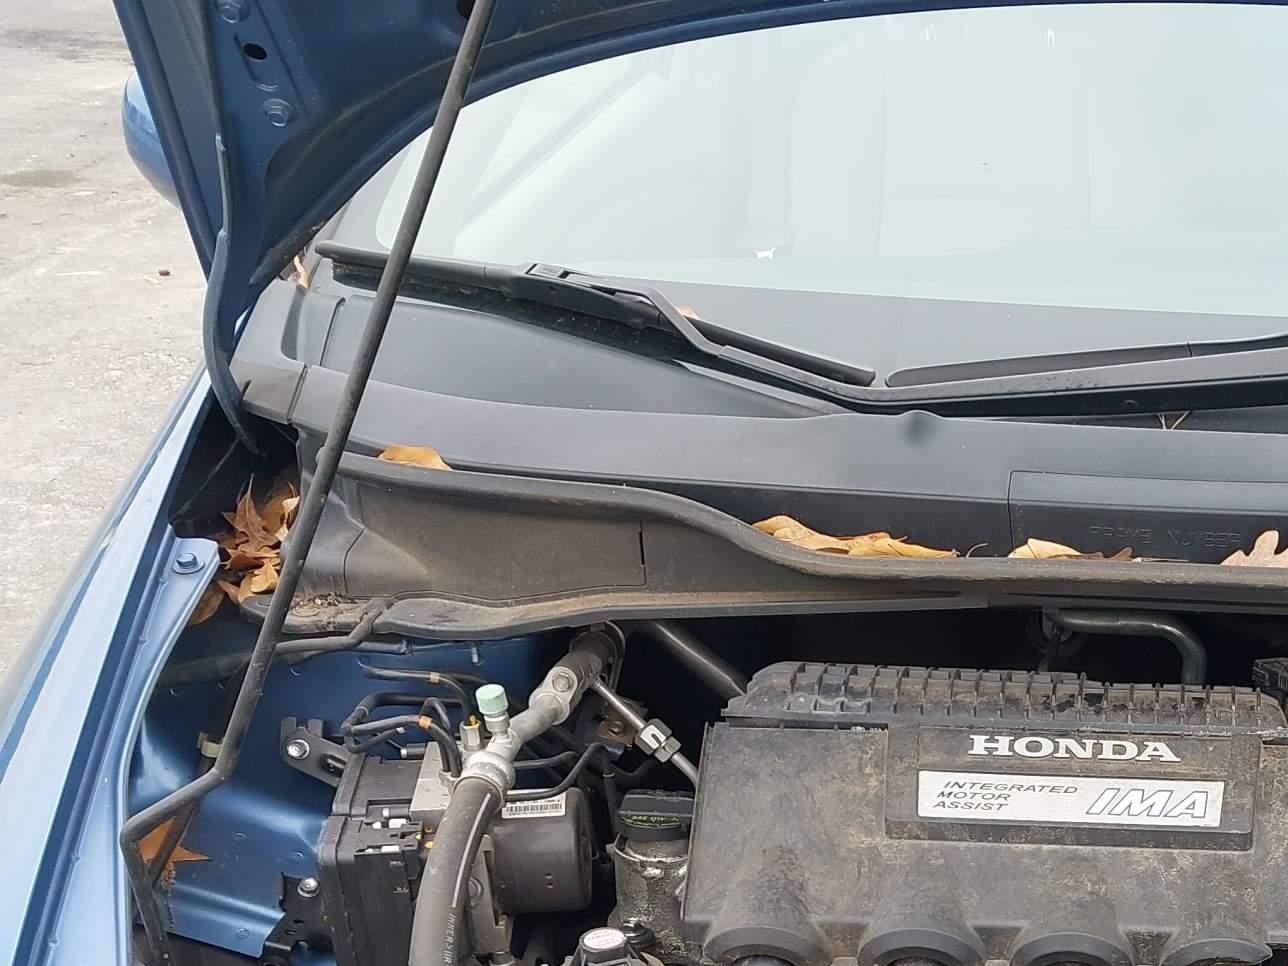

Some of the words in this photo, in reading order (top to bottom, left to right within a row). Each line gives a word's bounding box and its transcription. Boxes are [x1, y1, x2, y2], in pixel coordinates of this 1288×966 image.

[967, 734, 1182, 763] HONDA
[944, 780, 1078, 795] INTEGRATED
[937, 790, 1011, 802] MOTOR
[1085, 787, 1210, 819] IMA
[933, 800, 1009, 812] ASSIST
